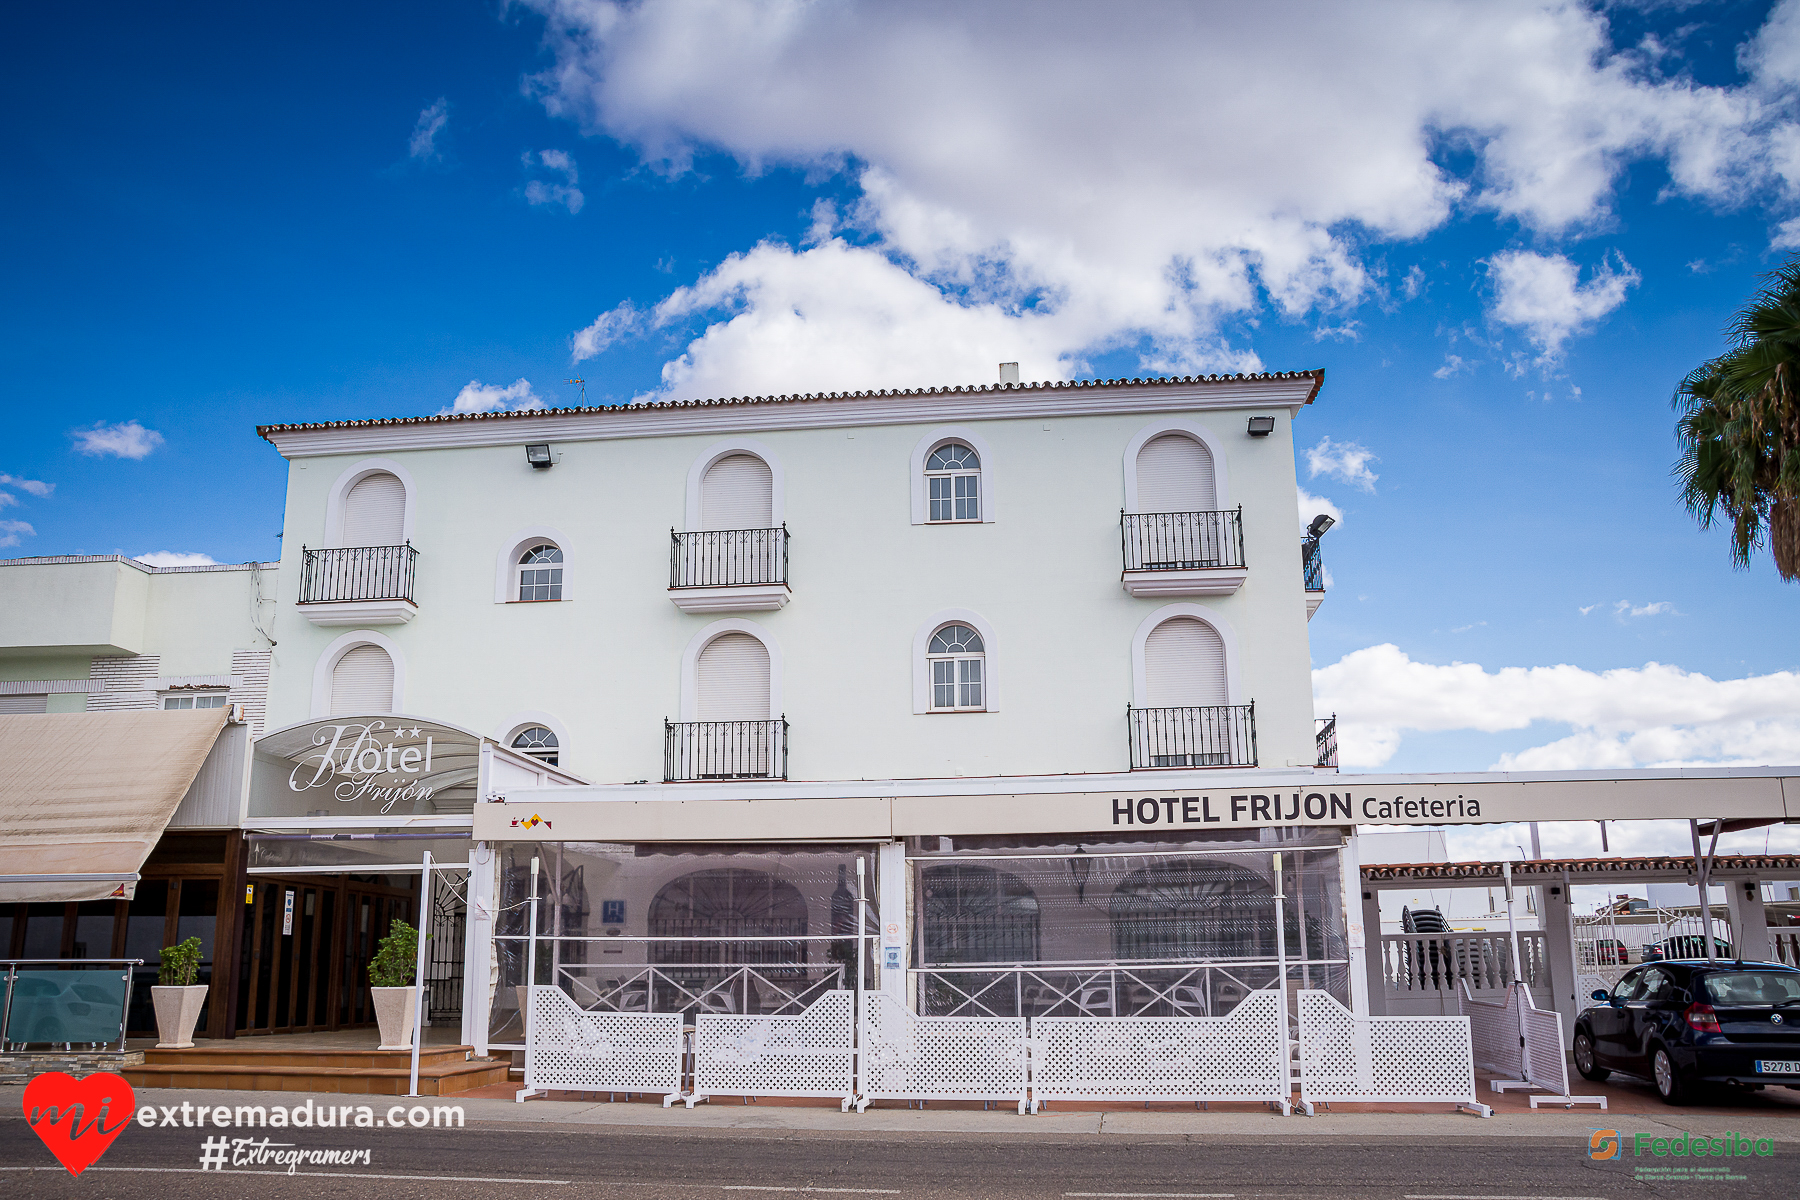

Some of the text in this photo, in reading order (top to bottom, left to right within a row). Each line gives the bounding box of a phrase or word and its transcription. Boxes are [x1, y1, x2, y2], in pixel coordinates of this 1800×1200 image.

[289, 720, 433, 792] Hotel
[335, 770, 435, 814] Frijón
[1112, 792, 1482, 825] HOTEL FRIJON Cafeteria
[608, 902, 619, 915] H
[1763, 1061, 1792, 1072] 5278
